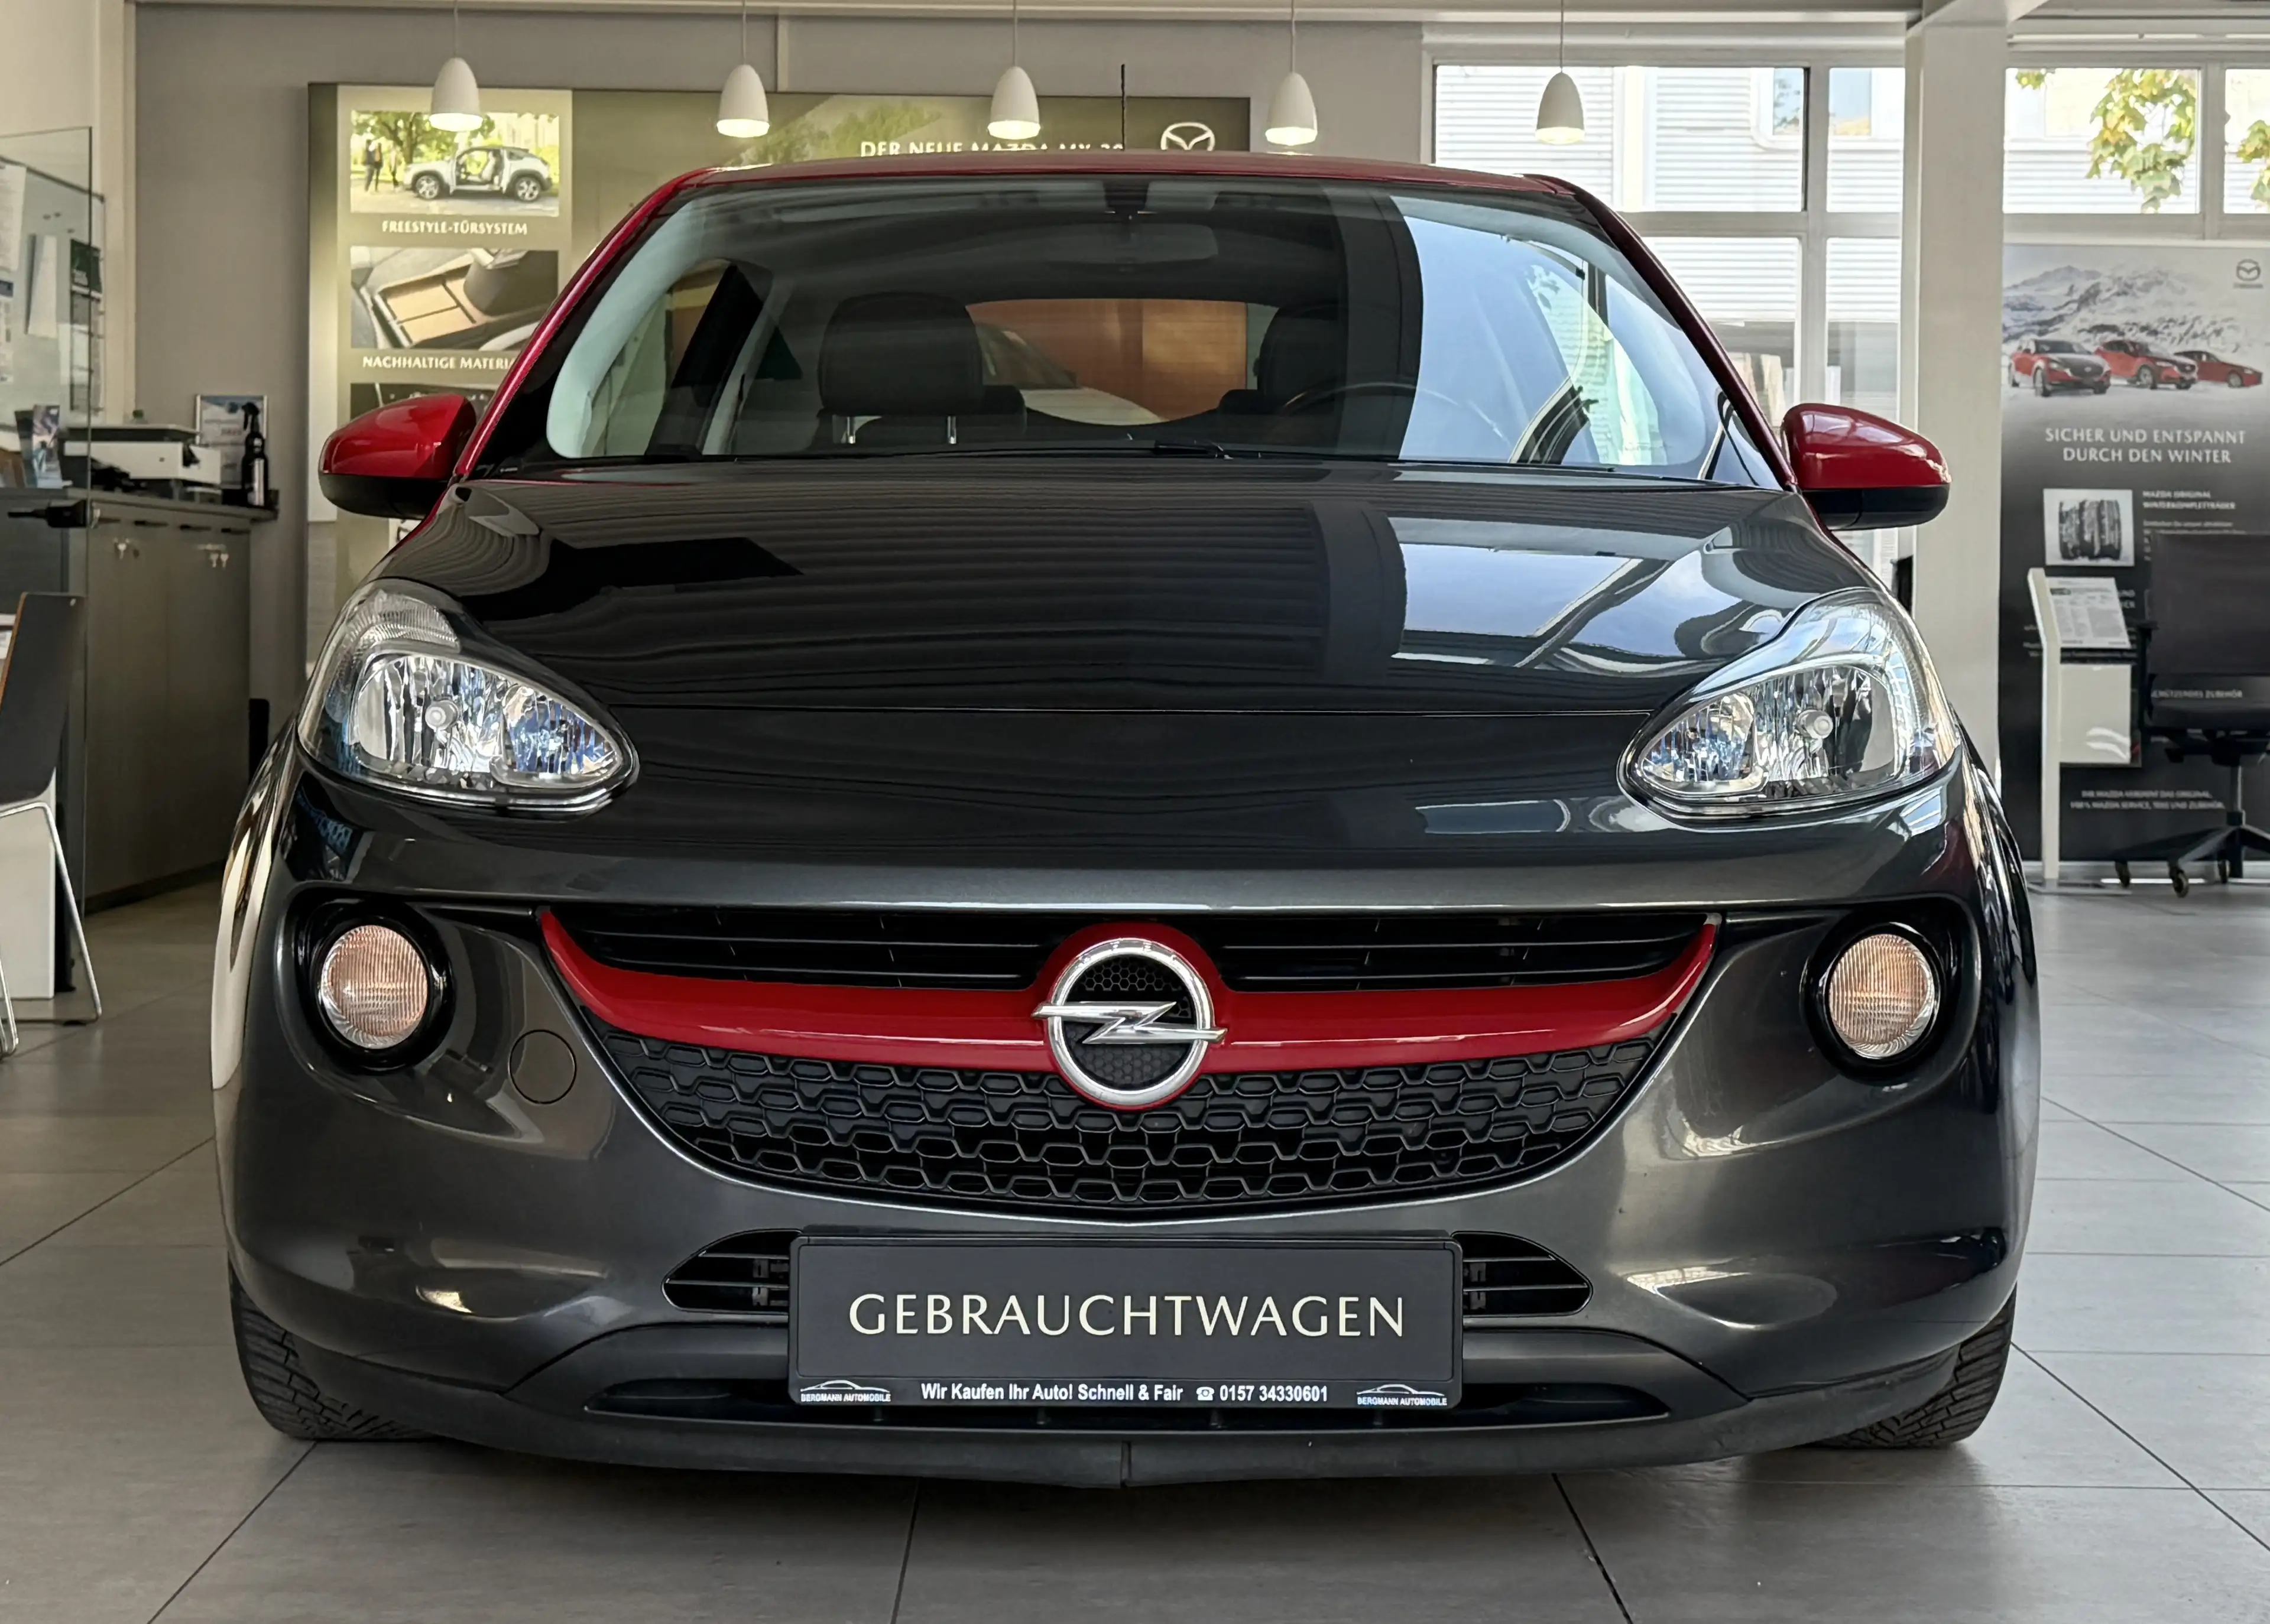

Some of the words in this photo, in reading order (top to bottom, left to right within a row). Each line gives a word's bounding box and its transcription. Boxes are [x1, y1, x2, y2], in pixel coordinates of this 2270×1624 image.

[860, 141, 901, 158] DER
[381, 219, 528, 235] FREESTYLE-TÜRSYSTEM
[362, 356, 456, 369] NACHHALTIGE
[2045, 427, 2105, 443] SICHER
[2110, 428, 2148, 443] UND
[2153, 429, 2247, 444] ENTSPANNT
[2063, 447, 2123, 462] DURCH
[2128, 448, 2162, 463] DEN
[2167, 449, 2232, 464] WINTER
[849, 1294, 1403, 1337] GEBRAUCHTWAGEN
[800, 1394, 842, 1402] BERGMANN
[843, 1393, 891, 1402] AUTOMOBILE
[920, 1382, 947, 1400] Wir
[951, 1383, 1004, 1401] Kaufen
[1008, 1383, 1027, 1401] Ihr
[1032, 1383, 1073, 1401] Auto!
[1078, 1383, 1134, 1401] Schnell
[1138, 1385, 1149, 1401] &
[1154, 1384, 1183, 1401] Fair
[1219, 1385, 1254, 1402] 0157
[1259, 1385, 1328, 1402] 34330601
[1357, 1396, 1399, 1405] BERGMANN
[1400, 1397, 1448, 1406] AUTOMOBILE
